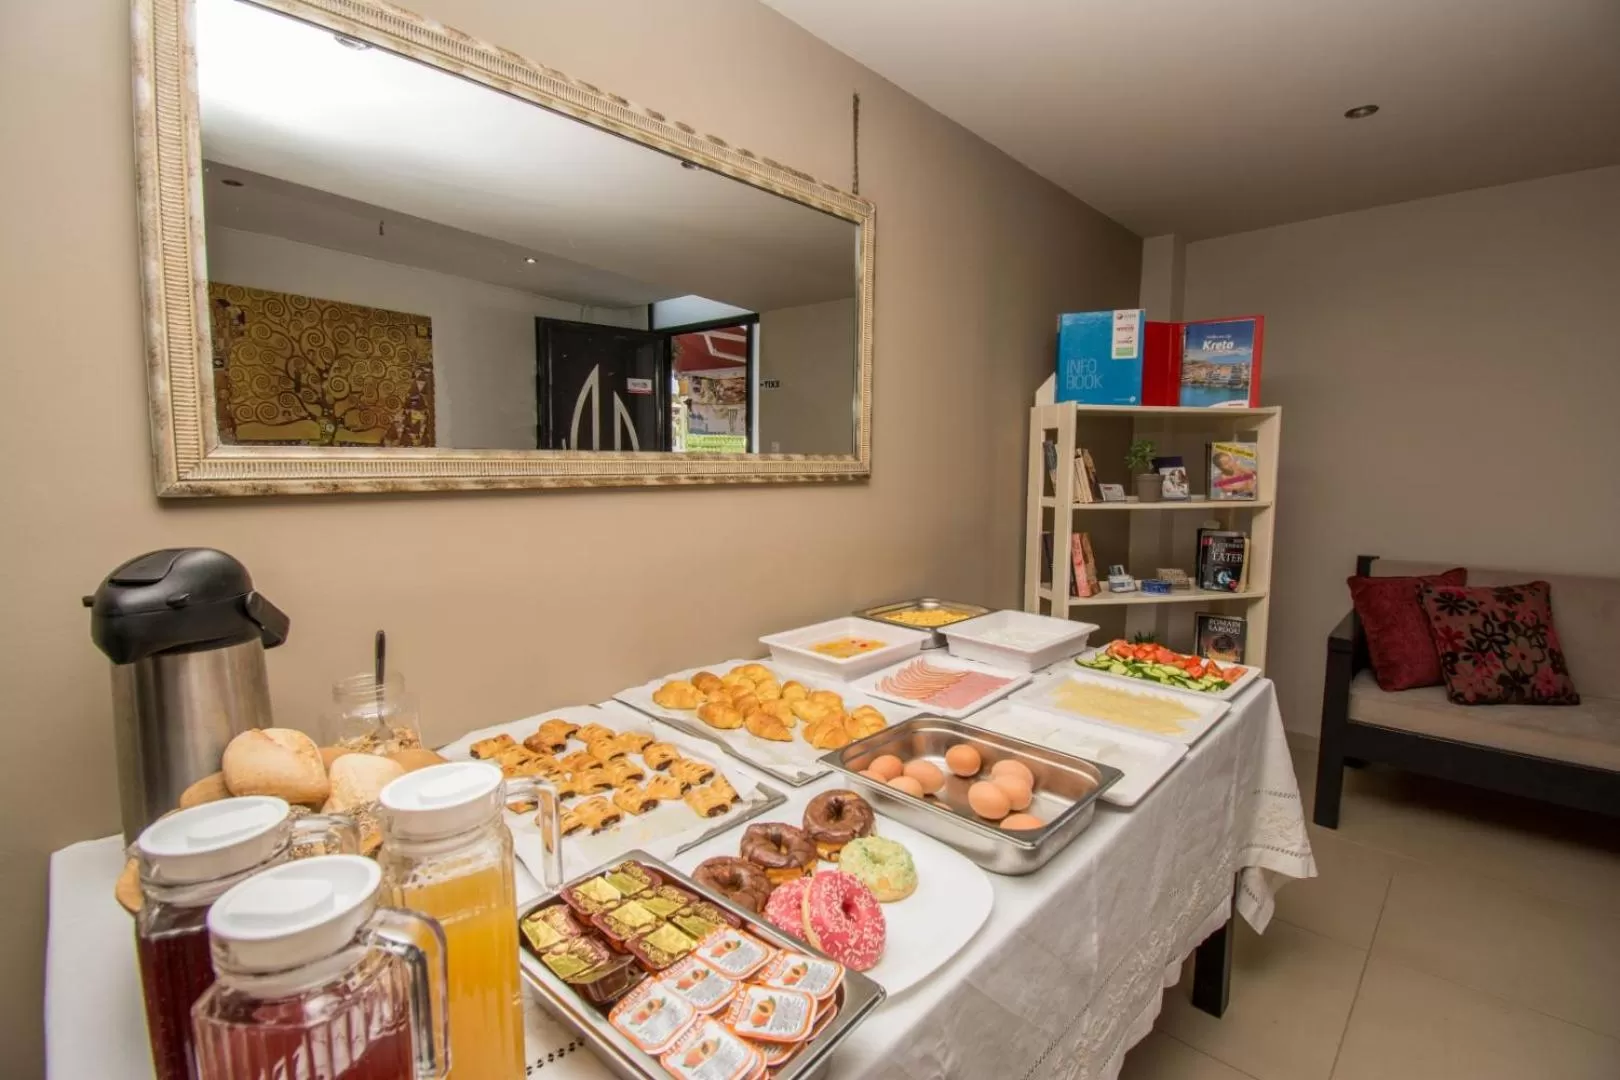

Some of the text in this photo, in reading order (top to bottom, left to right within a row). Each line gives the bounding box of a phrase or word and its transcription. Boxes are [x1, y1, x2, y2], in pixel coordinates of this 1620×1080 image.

[1202, 339, 1234, 351] Kreta
[1067, 358, 1096, 375] INFO
[1066, 374, 1104, 389] BOOK
